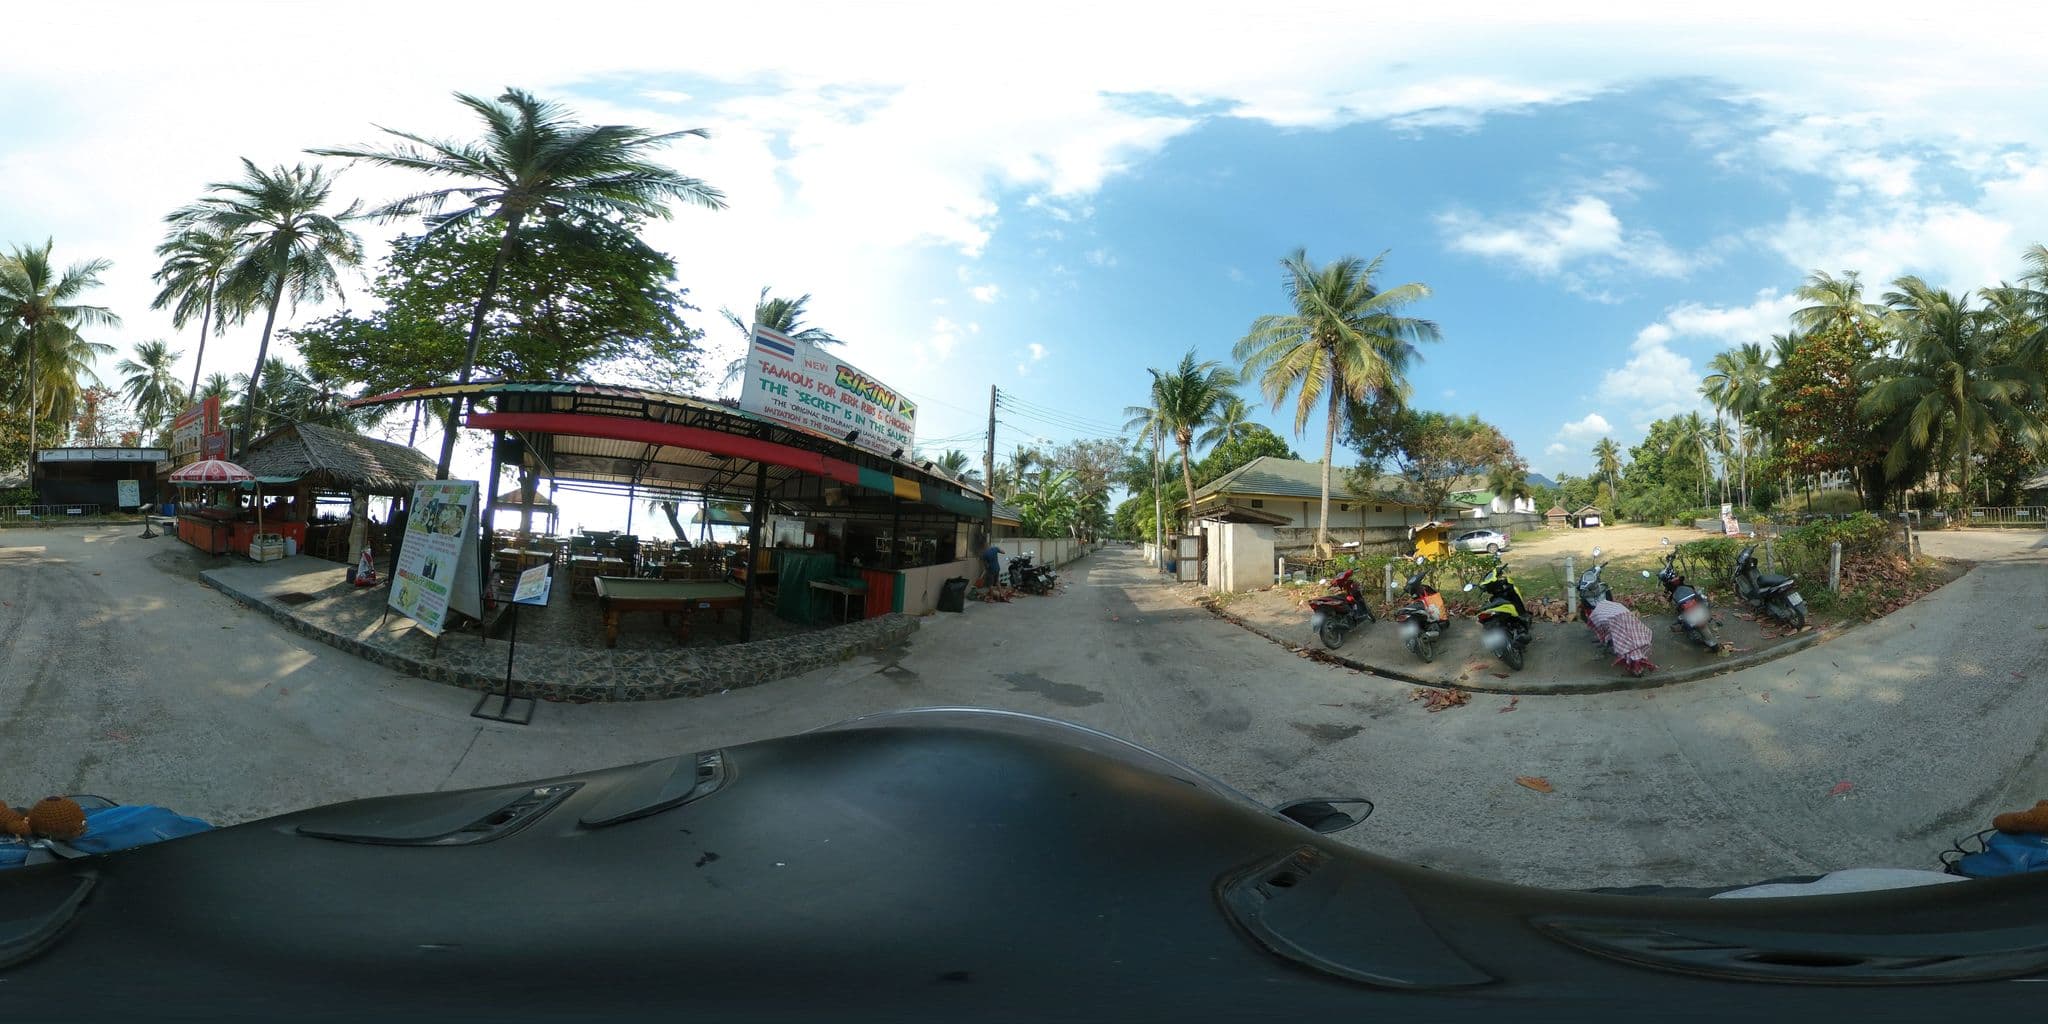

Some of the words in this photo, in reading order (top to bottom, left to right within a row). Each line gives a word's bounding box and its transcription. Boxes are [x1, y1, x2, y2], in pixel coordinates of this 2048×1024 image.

[758, 360, 814, 389] "FAMOUS
[817, 381, 836, 398] FOR
[839, 392, 859, 408] JERK
[877, 410, 883, 420] &
[804, 359, 829, 372] NEW
[835, 364, 897, 412] BIKINI
[759, 377, 789, 398] THE
[794, 389, 841, 414] "SECRET"
[844, 409, 852, 420] IS
[855, 413, 866, 426] IN
[869, 419, 887, 434] THE
